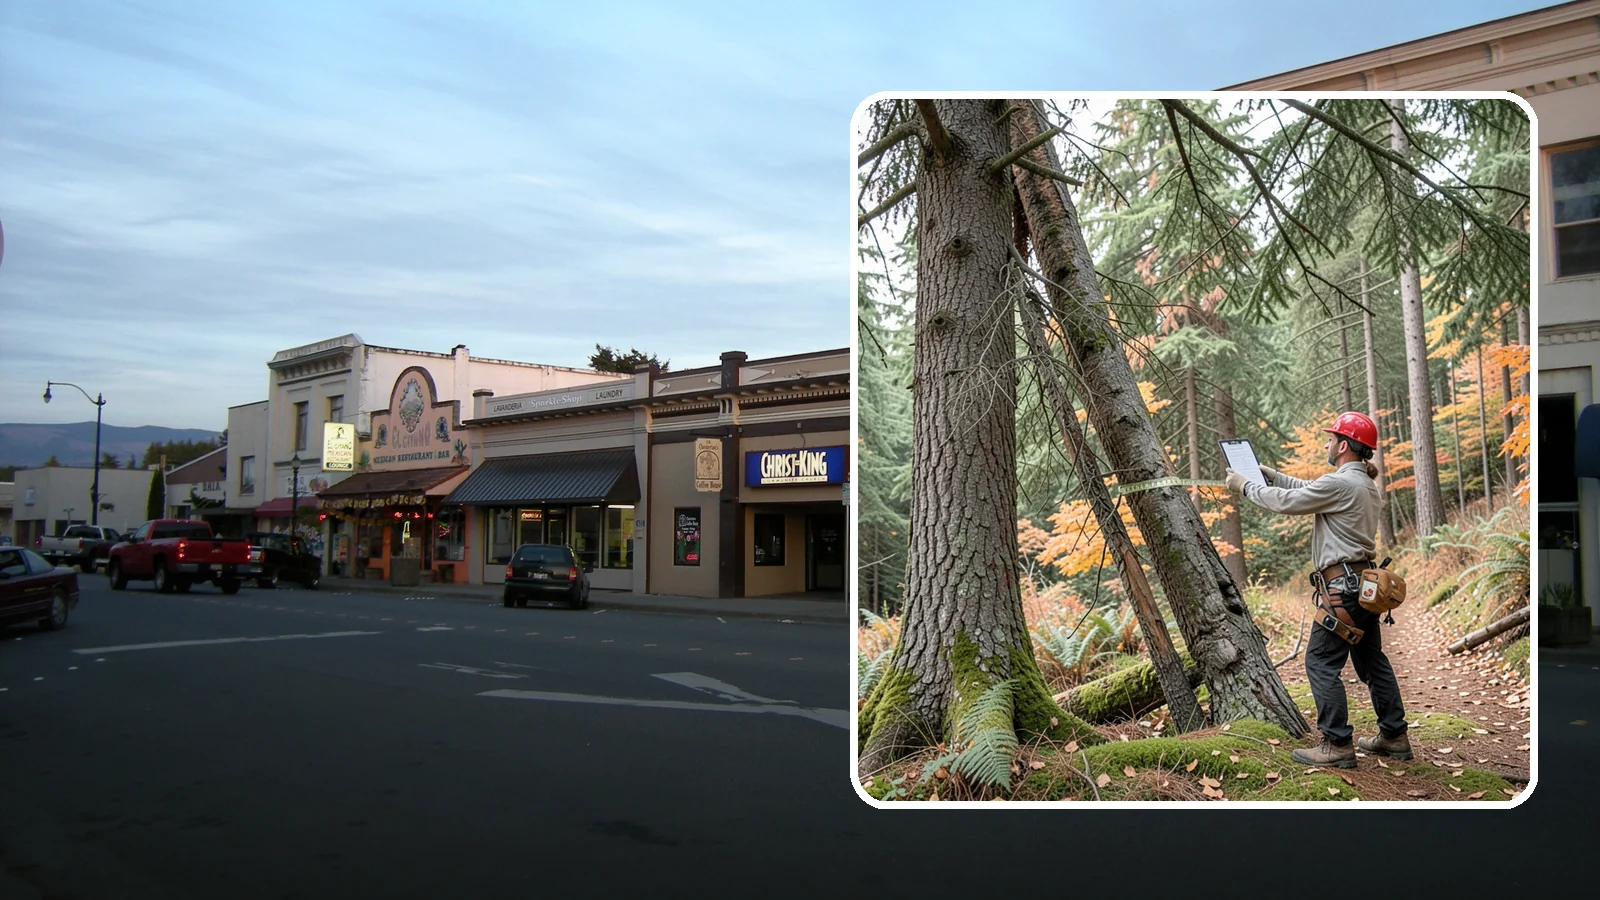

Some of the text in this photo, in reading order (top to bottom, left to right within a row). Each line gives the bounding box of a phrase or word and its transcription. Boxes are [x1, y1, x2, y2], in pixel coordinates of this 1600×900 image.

[562, 394, 582, 404] Shop
[595, 389, 623, 400] LAUNDRY
[493, 402, 522, 413] LAVANDERIA
[373, 455, 396, 464] MEXICAN
[397, 451, 434, 463] RESTAURANT
[438, 450, 450, 459] BAR
[760, 450, 827, 478] CHRIST KING
